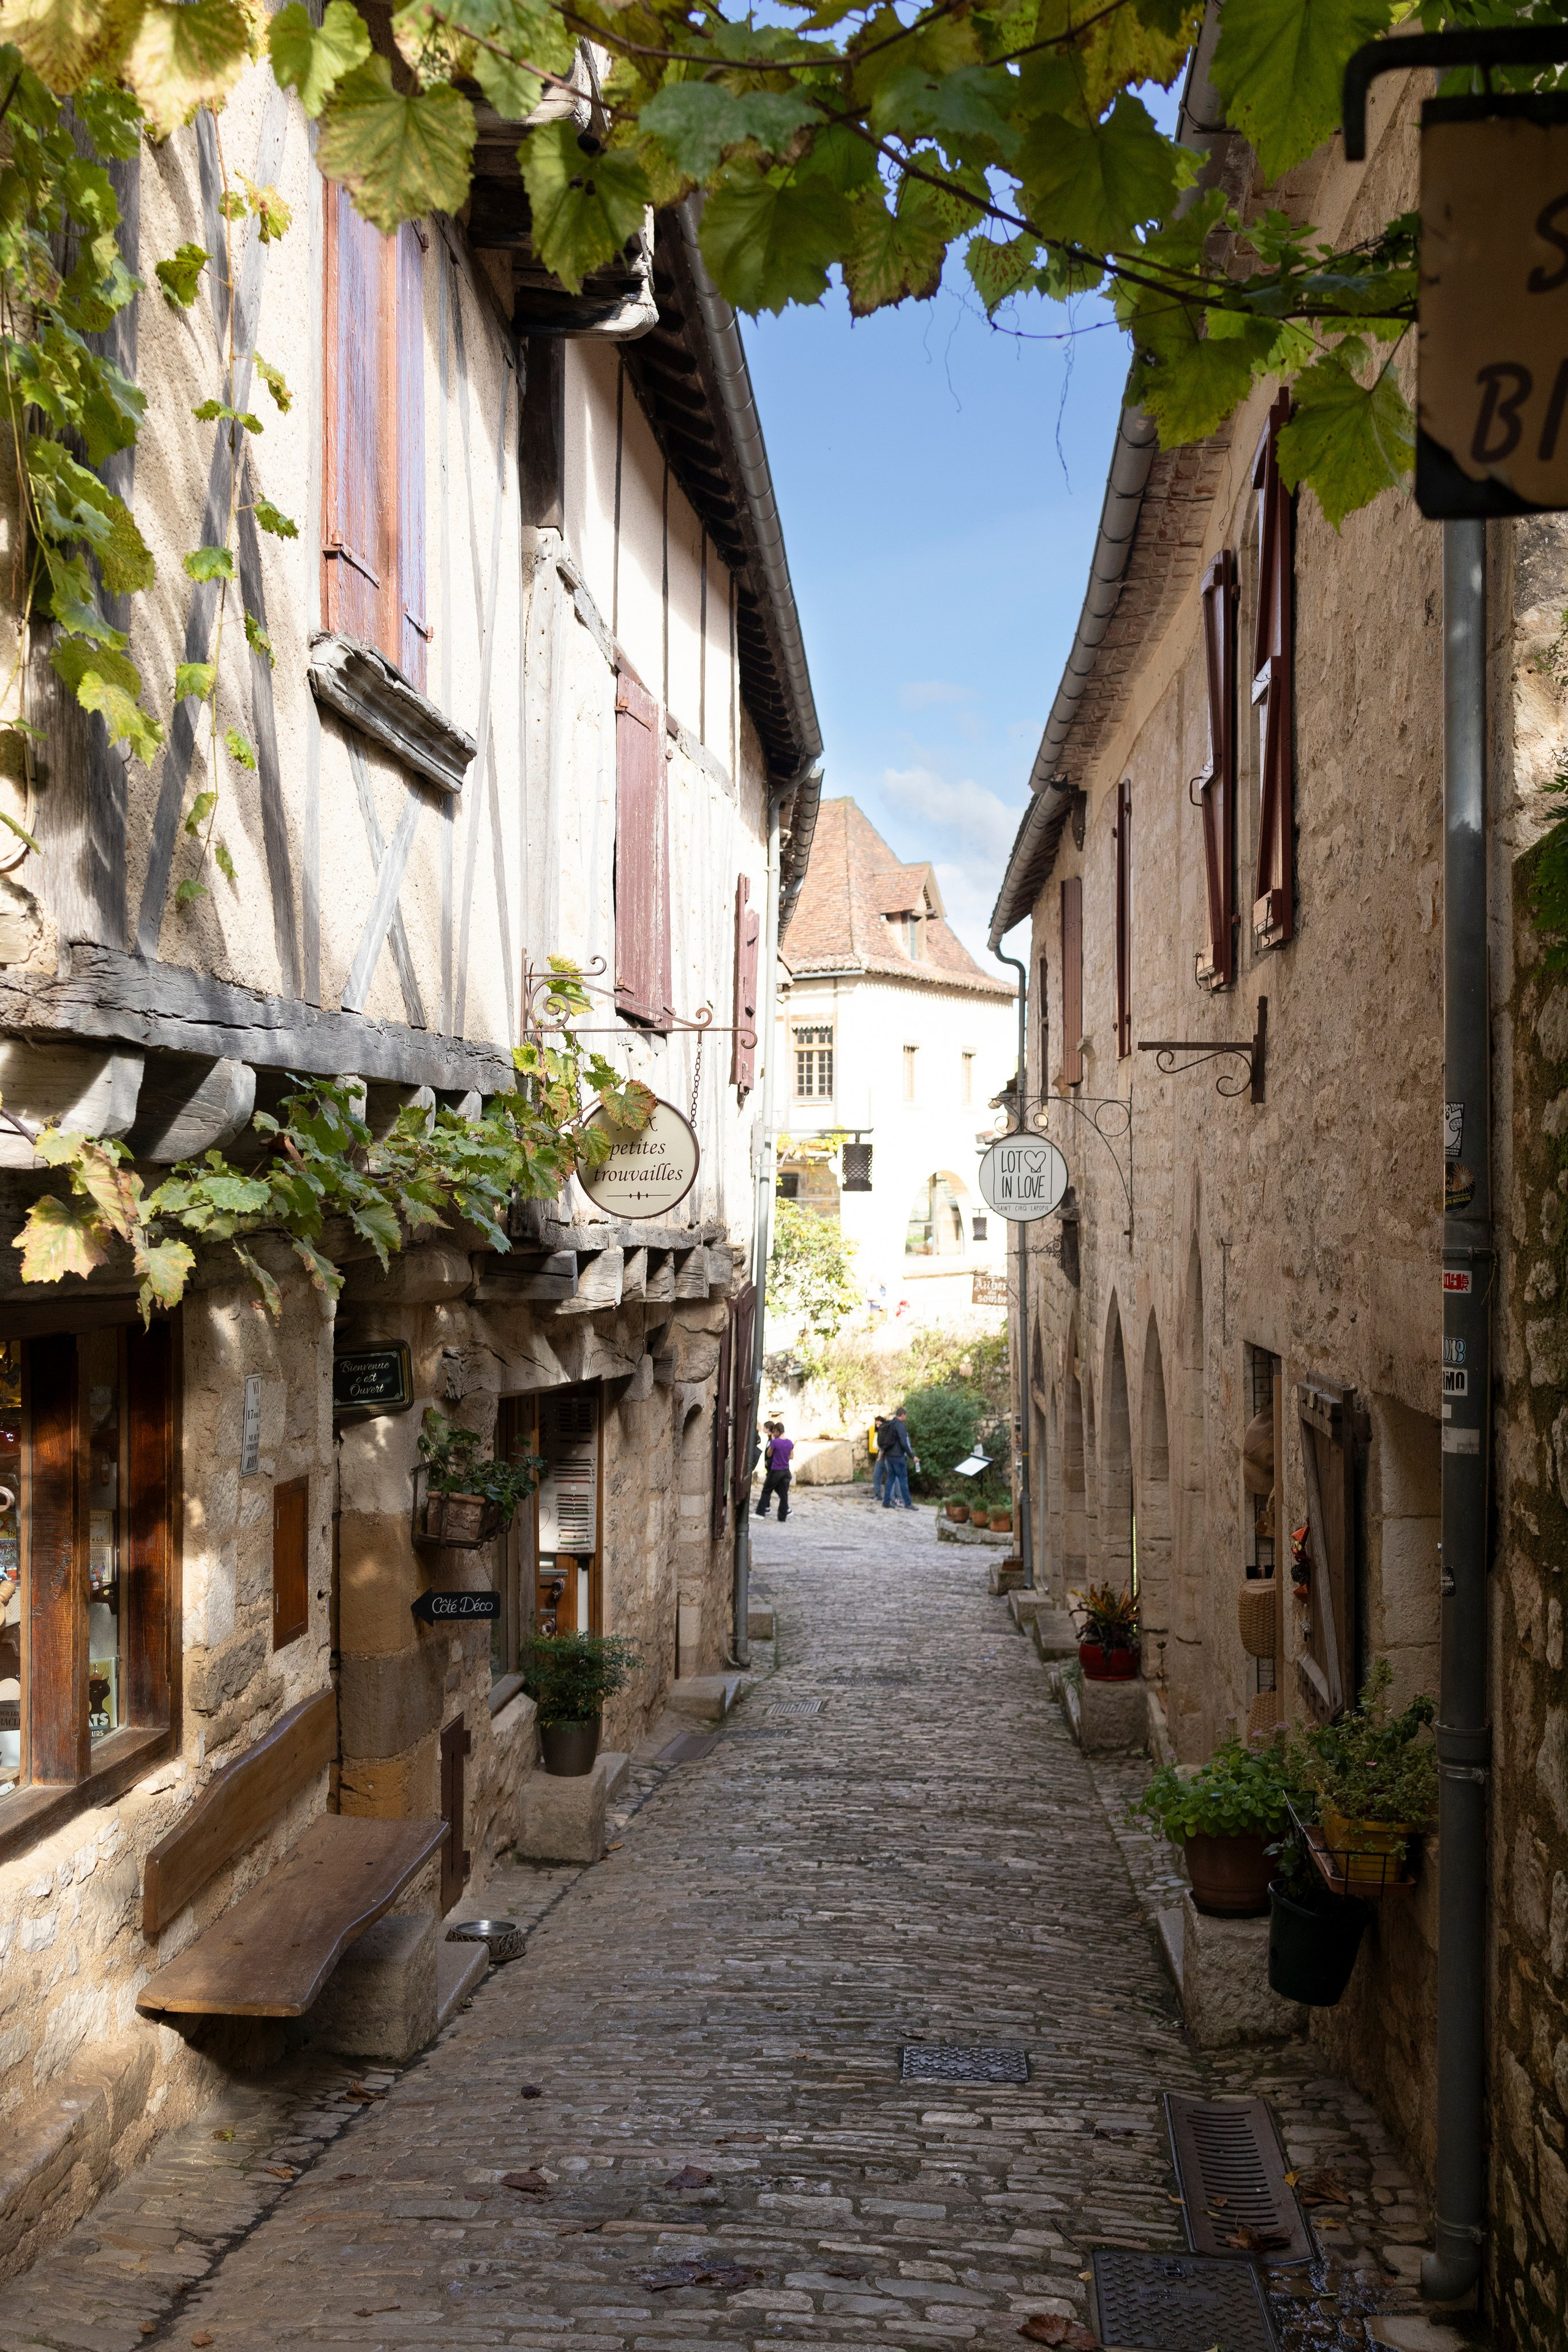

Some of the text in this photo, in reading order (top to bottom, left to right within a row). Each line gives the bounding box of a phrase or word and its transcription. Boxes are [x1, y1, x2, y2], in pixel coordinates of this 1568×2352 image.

[608, 1138, 666, 1161] petites
[1001, 1150, 1023, 1174] LOT
[594, 1163, 684, 1182] trouvailles
[1002, 1175, 1046, 1198] IN LOVE
[340, 1360, 390, 1373] Bienvenue
[356, 1372, 377, 1383] c'est
[349, 1384, 385, 1396] Ouvert
[247, 1409, 254, 1420] 17
[432, 1596, 493, 1614] Côté Déco
